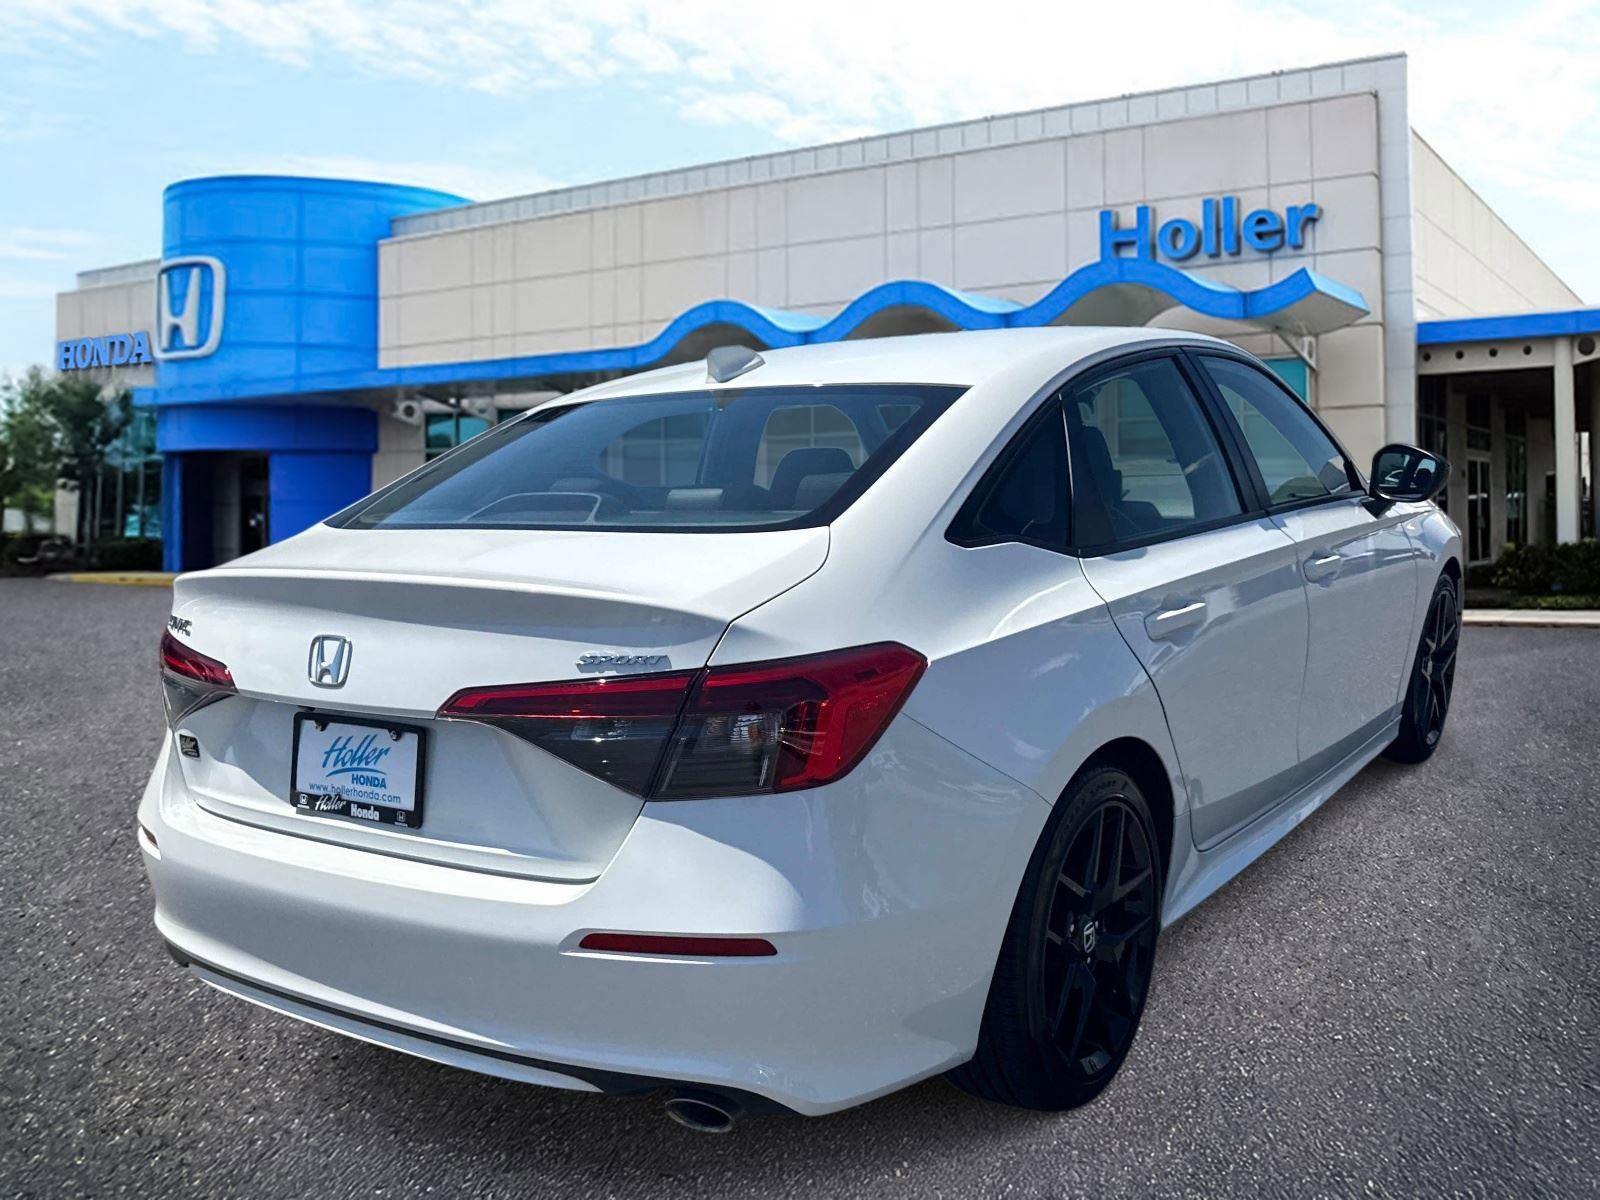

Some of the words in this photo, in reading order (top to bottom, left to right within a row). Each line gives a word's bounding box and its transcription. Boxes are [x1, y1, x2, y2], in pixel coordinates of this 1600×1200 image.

[1099, 195, 1322, 262] Holler
[58, 331, 152, 371] HONDA
[576, 654, 672, 674] SPORT
[322, 734, 391, 768] Holler
[309, 782, 401, 803] www.hollerhonda.com
[351, 774, 387, 789] HONDA
[315, 794, 346, 811] Holler
[350, 803, 380, 820] Honda
